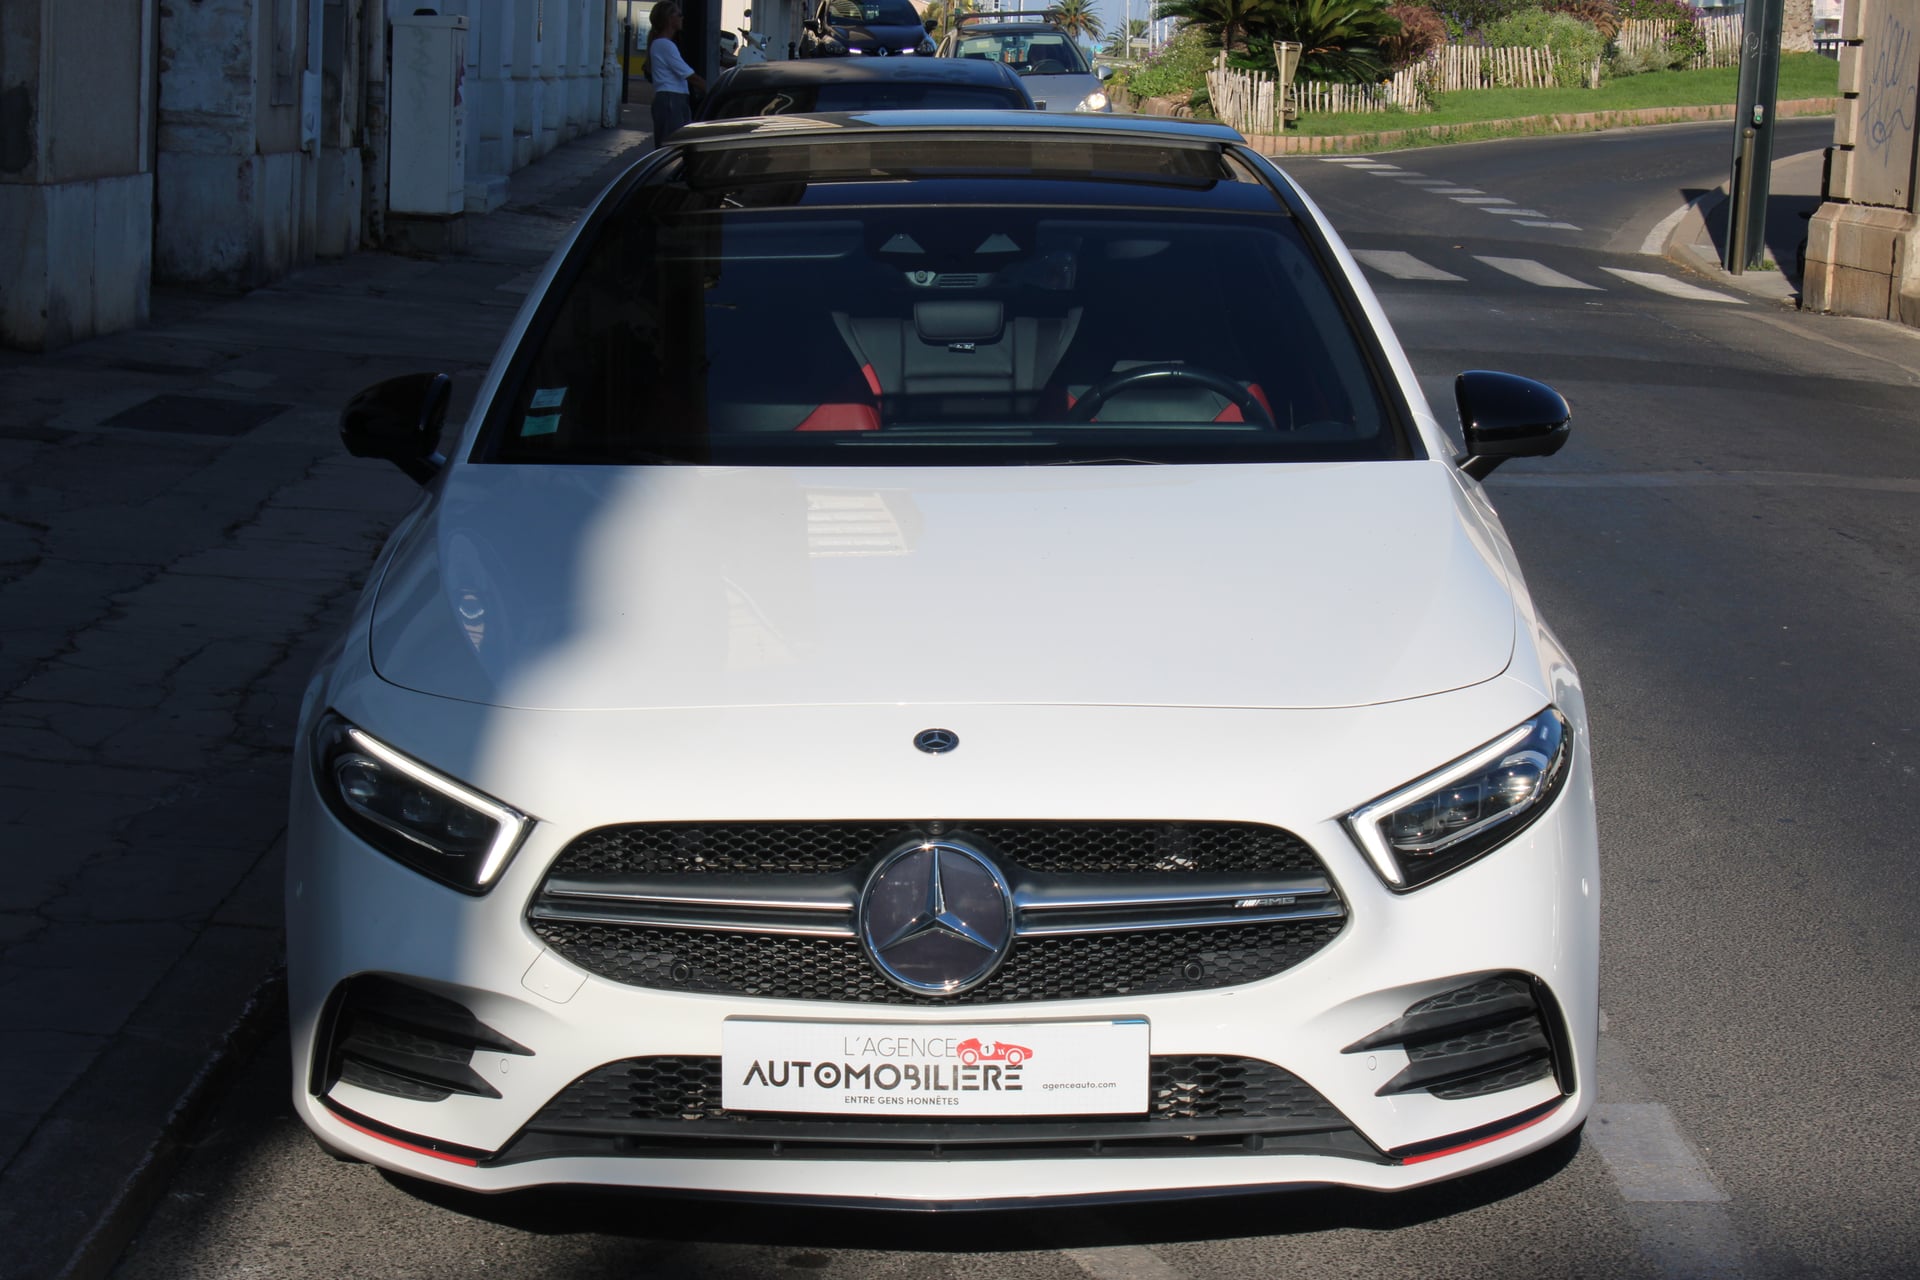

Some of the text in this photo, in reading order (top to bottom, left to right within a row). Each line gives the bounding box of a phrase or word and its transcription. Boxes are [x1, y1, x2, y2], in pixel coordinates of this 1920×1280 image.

[1253, 896, 1295, 906] AMG
[844, 1037, 956, 1057] L'AGENCE
[743, 1060, 1023, 1091] AUTOMOBILIERE
[1042, 1081, 1116, 1091] agenceauto.com
[844, 1095, 959, 1106] ENTRE GENS HONNÊTES
